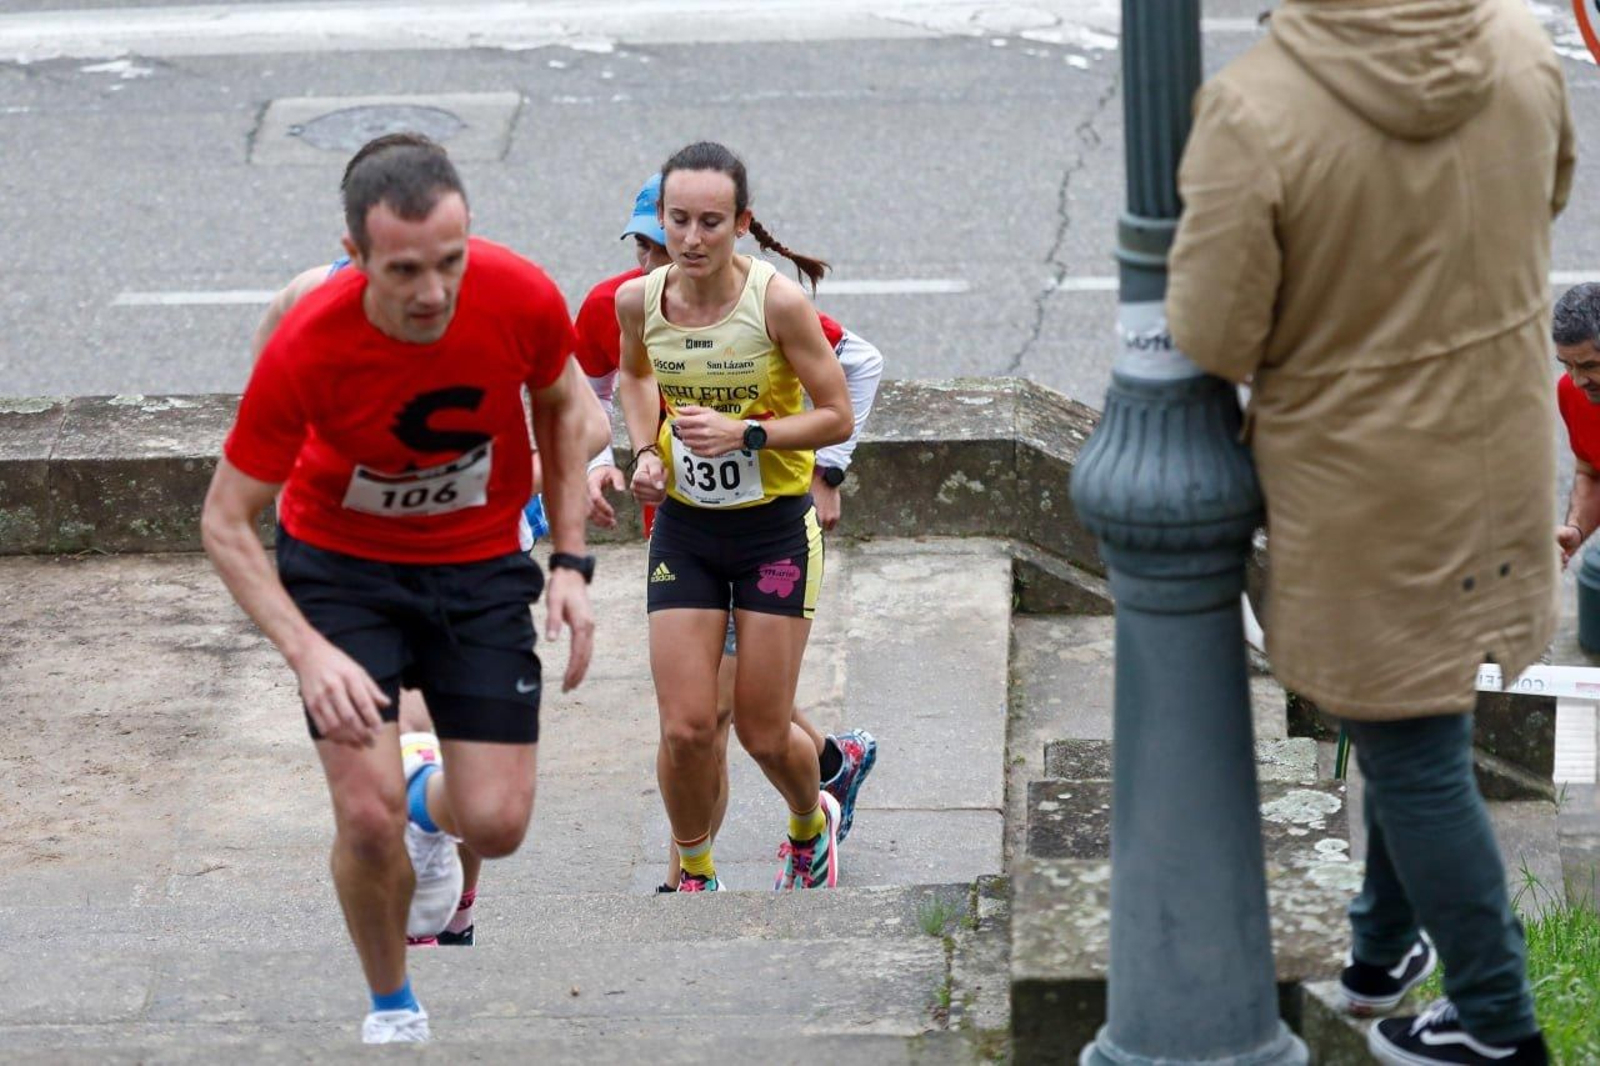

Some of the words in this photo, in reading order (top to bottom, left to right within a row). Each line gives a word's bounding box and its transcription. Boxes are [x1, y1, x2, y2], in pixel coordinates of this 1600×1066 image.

[707, 361, 722, 370] San
[724, 359, 754, 370] Lázaro
[683, 455, 741, 492] 330
[381, 481, 459, 509] 106
[650, 573, 676, 583] adidas
